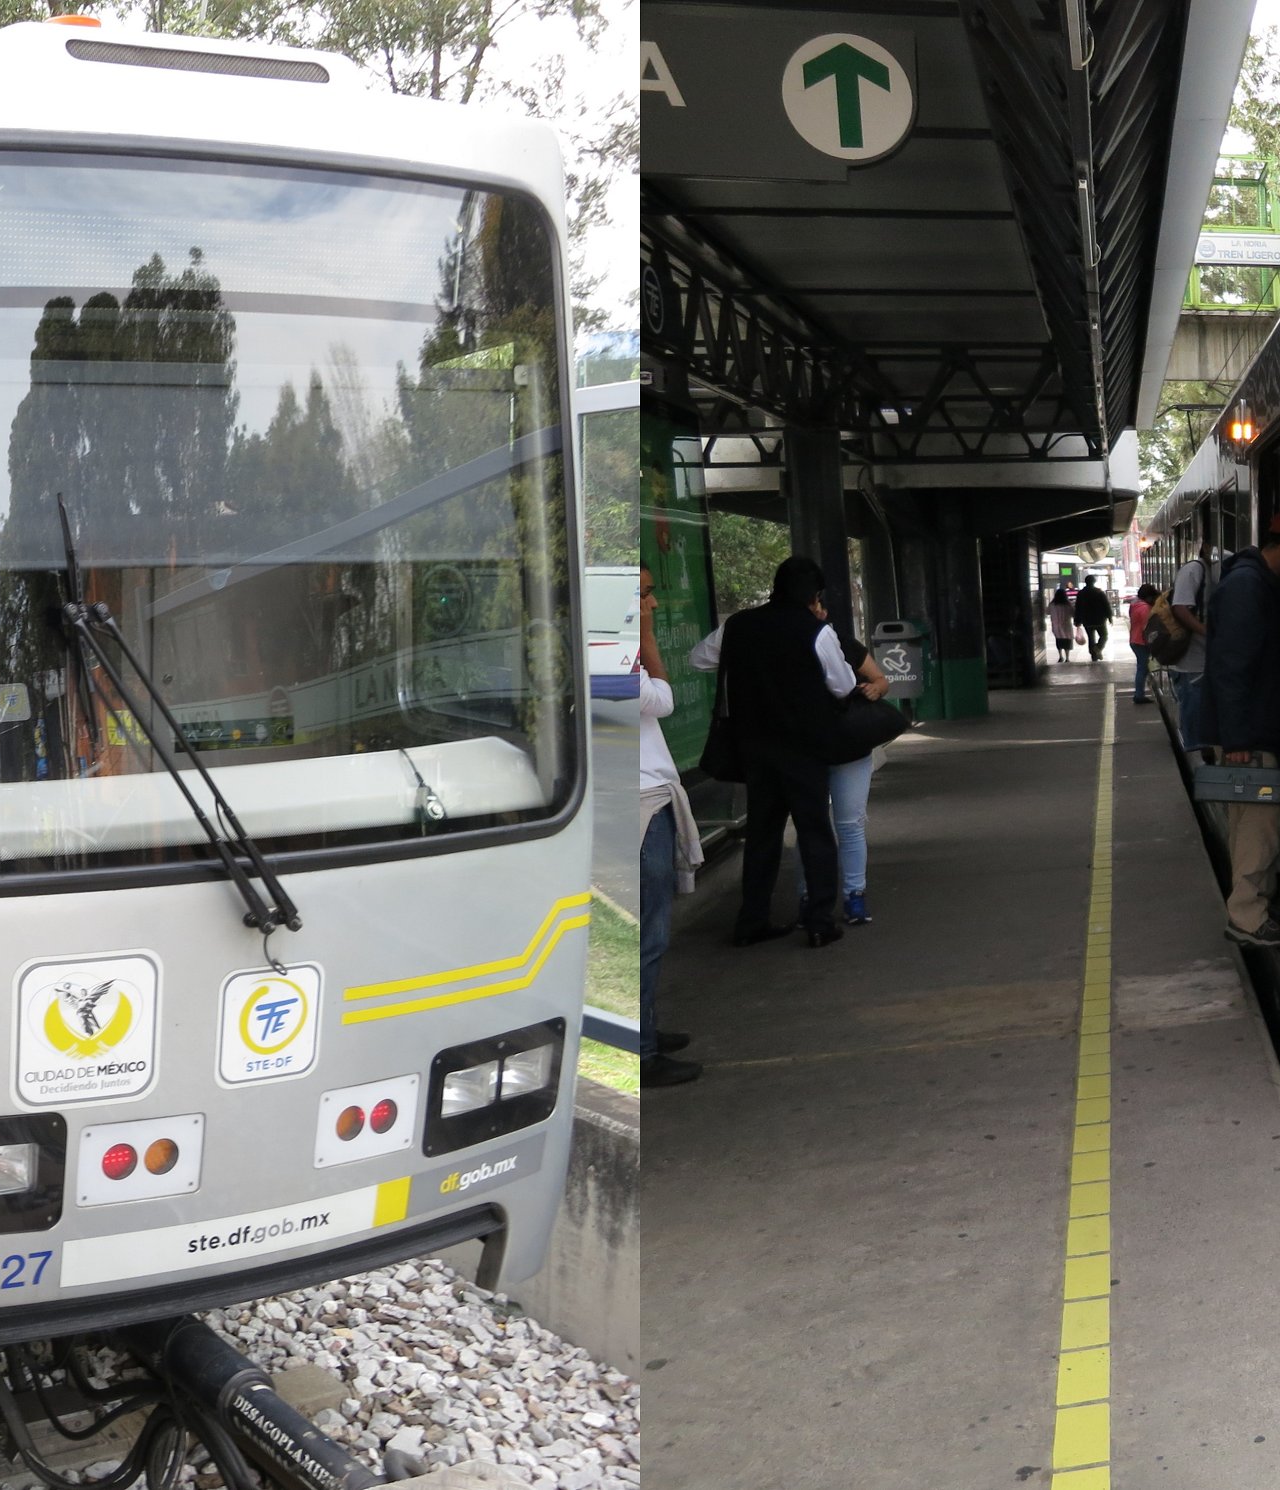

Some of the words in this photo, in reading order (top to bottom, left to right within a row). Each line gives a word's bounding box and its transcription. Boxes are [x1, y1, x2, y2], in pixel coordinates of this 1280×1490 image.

[1217, 249, 1243, 259] TREN
[1247, 250, 1280, 260] LIGERO
[24, 1068, 75, 1083] CIUDAD
[76, 1066, 95, 1079] DE
[96, 1060, 147, 1076] MÉXICO
[245, 1056, 293, 1073] STE-DF
[39, 1079, 98, 1095] Decidiendo
[99, 1077, 131, 1090] Juntos
[439, 1155, 518, 1195] df.gob.mx
[187, 1210, 331, 1255] ste.df.gob.mx
